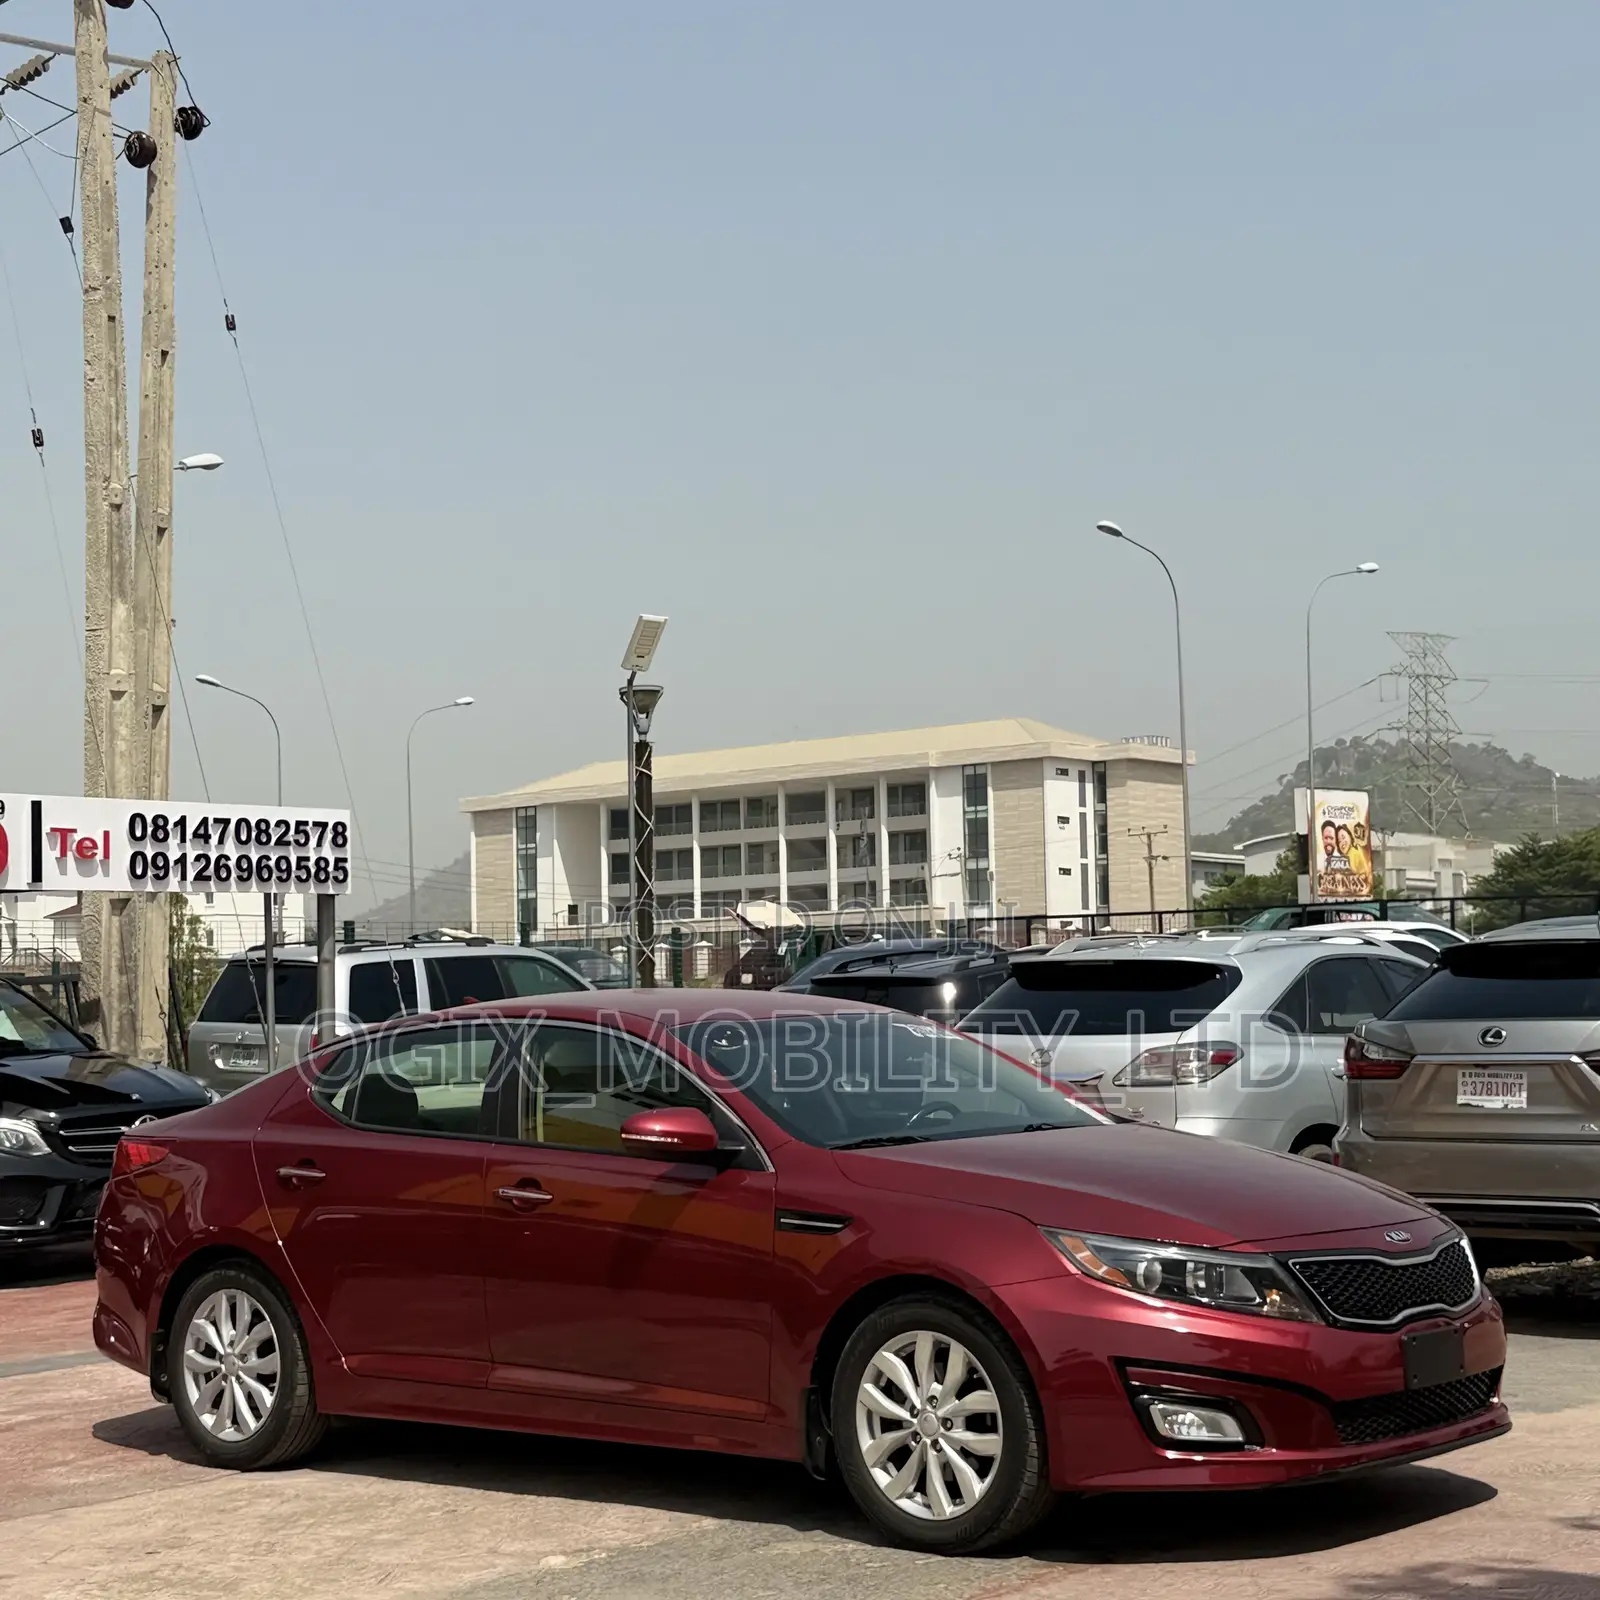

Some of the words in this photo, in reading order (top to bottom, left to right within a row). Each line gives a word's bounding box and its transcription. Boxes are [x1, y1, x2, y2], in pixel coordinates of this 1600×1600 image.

[50, 827, 110, 860] Tel
[128, 812, 348, 848] 08147082578
[129, 850, 349, 884] 09126969585
